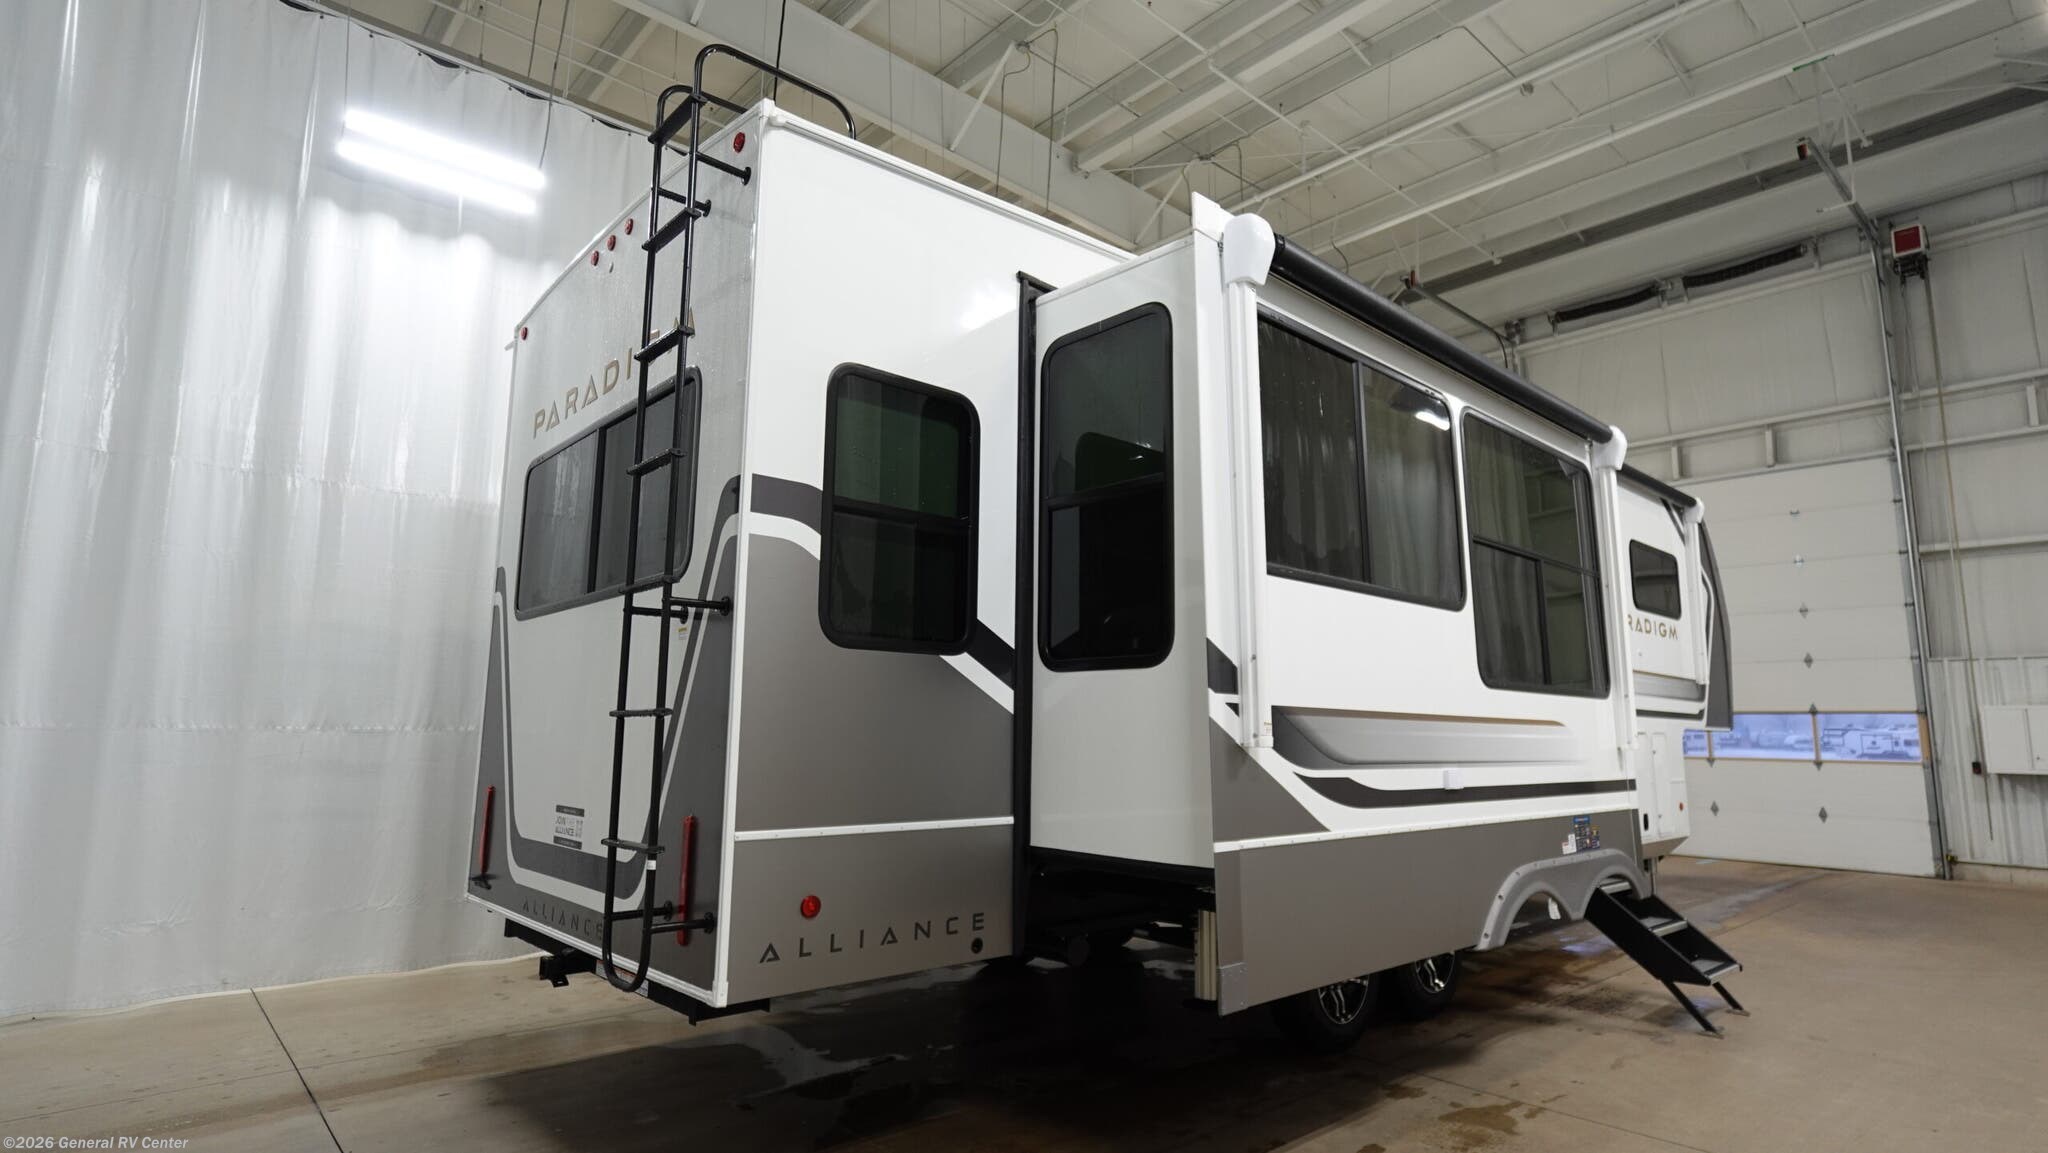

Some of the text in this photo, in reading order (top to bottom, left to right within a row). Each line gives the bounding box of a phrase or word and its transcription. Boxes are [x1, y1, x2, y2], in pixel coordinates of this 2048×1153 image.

[533, 306, 696, 439] PARADI
[1627, 613, 1679, 640] RADIGM
[522, 896, 603, 940] ALLIANCE
[759, 912, 985, 963] ALLIANCE
